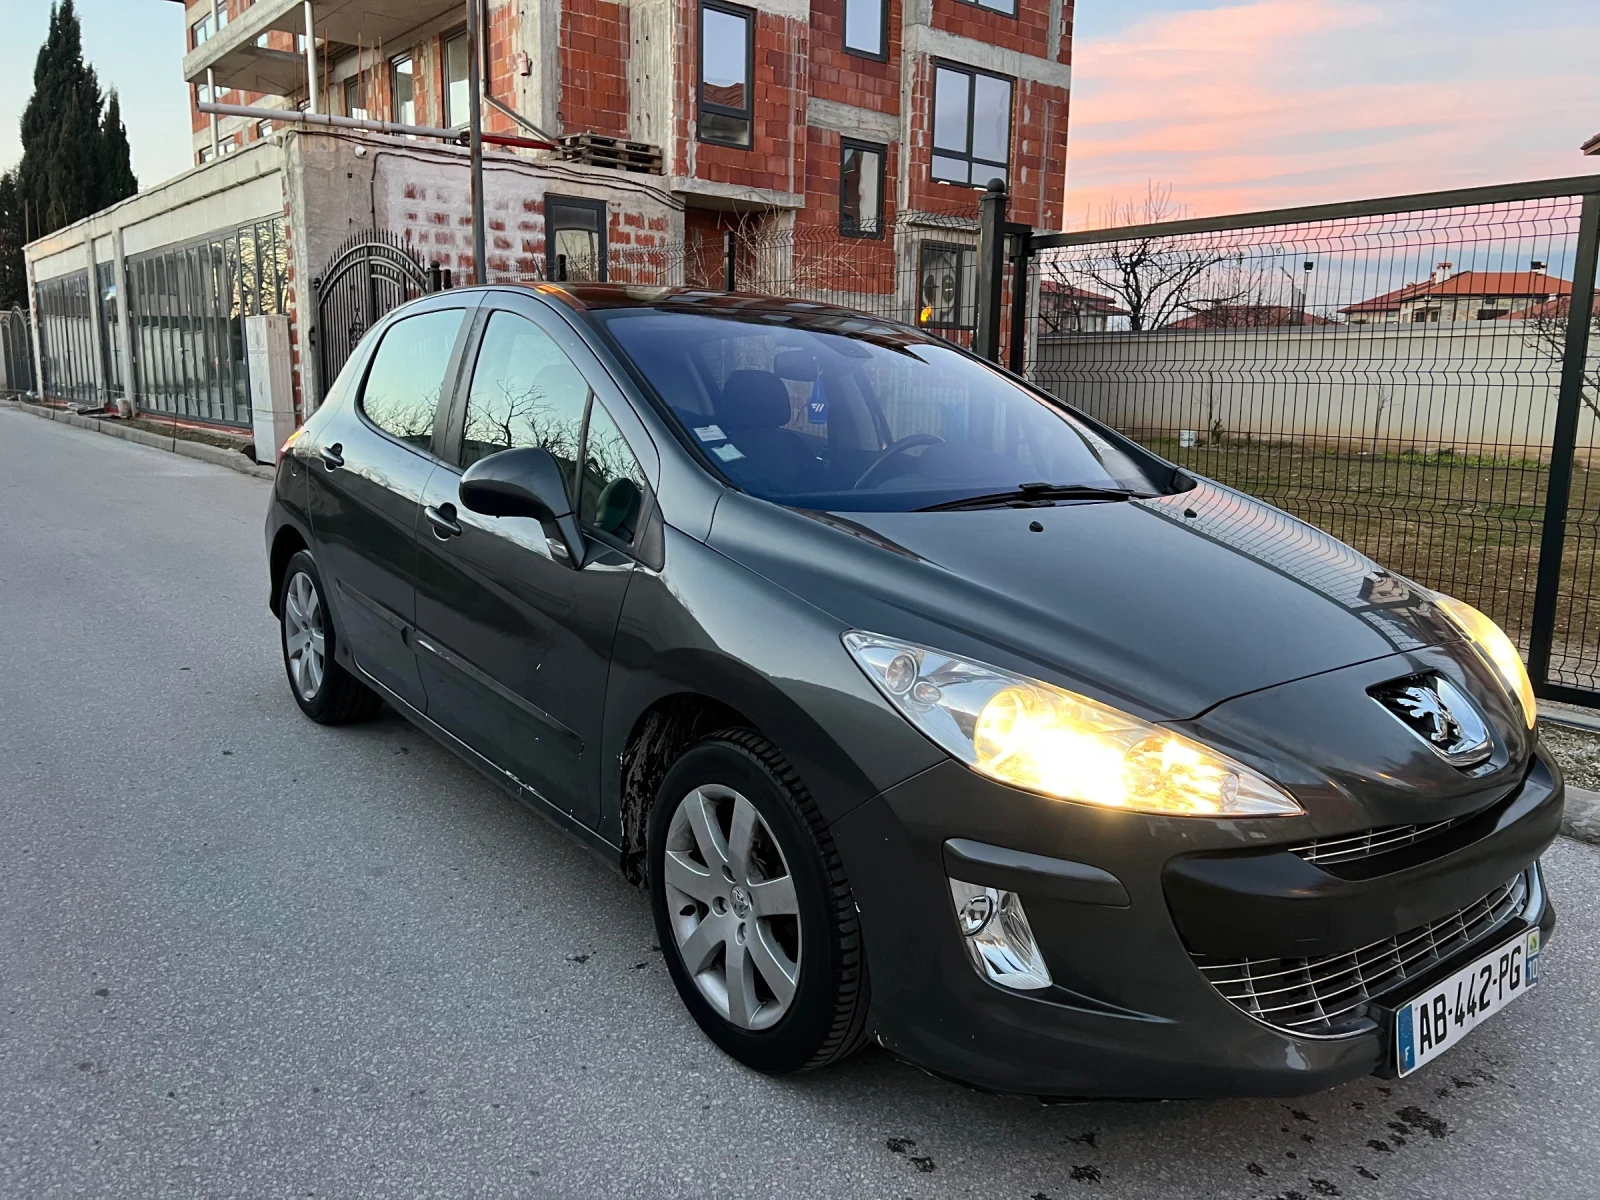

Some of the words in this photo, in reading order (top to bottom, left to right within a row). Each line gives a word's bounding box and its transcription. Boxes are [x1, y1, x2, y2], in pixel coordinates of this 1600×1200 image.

[1528, 958, 1538, 980] 10
[1420, 945, 1521, 1056] AB-442-PG
[1404, 1045, 1410, 1062] F
